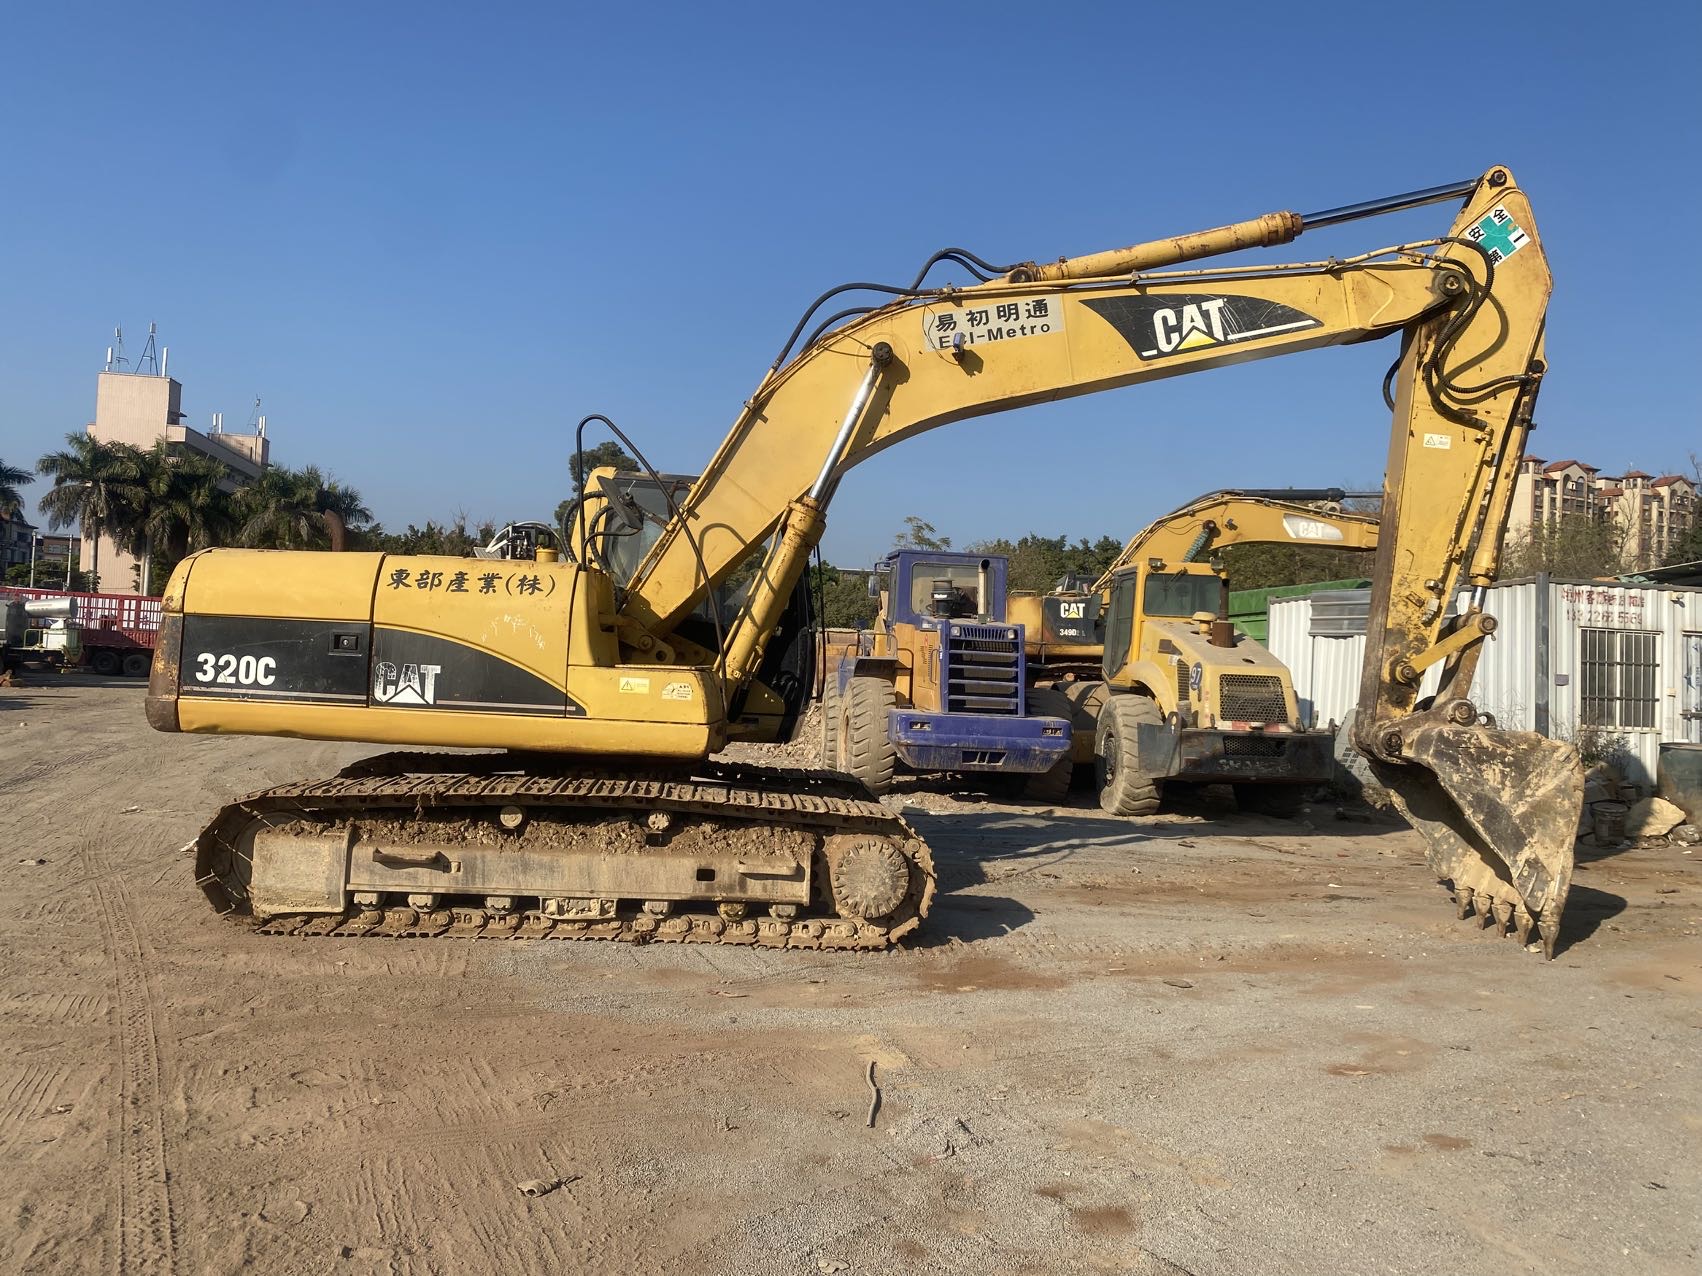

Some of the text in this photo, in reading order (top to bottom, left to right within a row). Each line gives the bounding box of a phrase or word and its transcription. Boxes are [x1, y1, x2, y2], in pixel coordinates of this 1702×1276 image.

[935, 298, 1049, 332] 易初明通
[1152, 298, 1225, 352] CAT
[938, 323, 1051, 349] EI-Metro
[1299, 521, 1324, 538] CAT
[1060, 602, 1086, 619] CAT
[195, 652, 277, 686] 320C
[373, 661, 442, 705] CAT
[1191, 667, 1202, 684] 97
